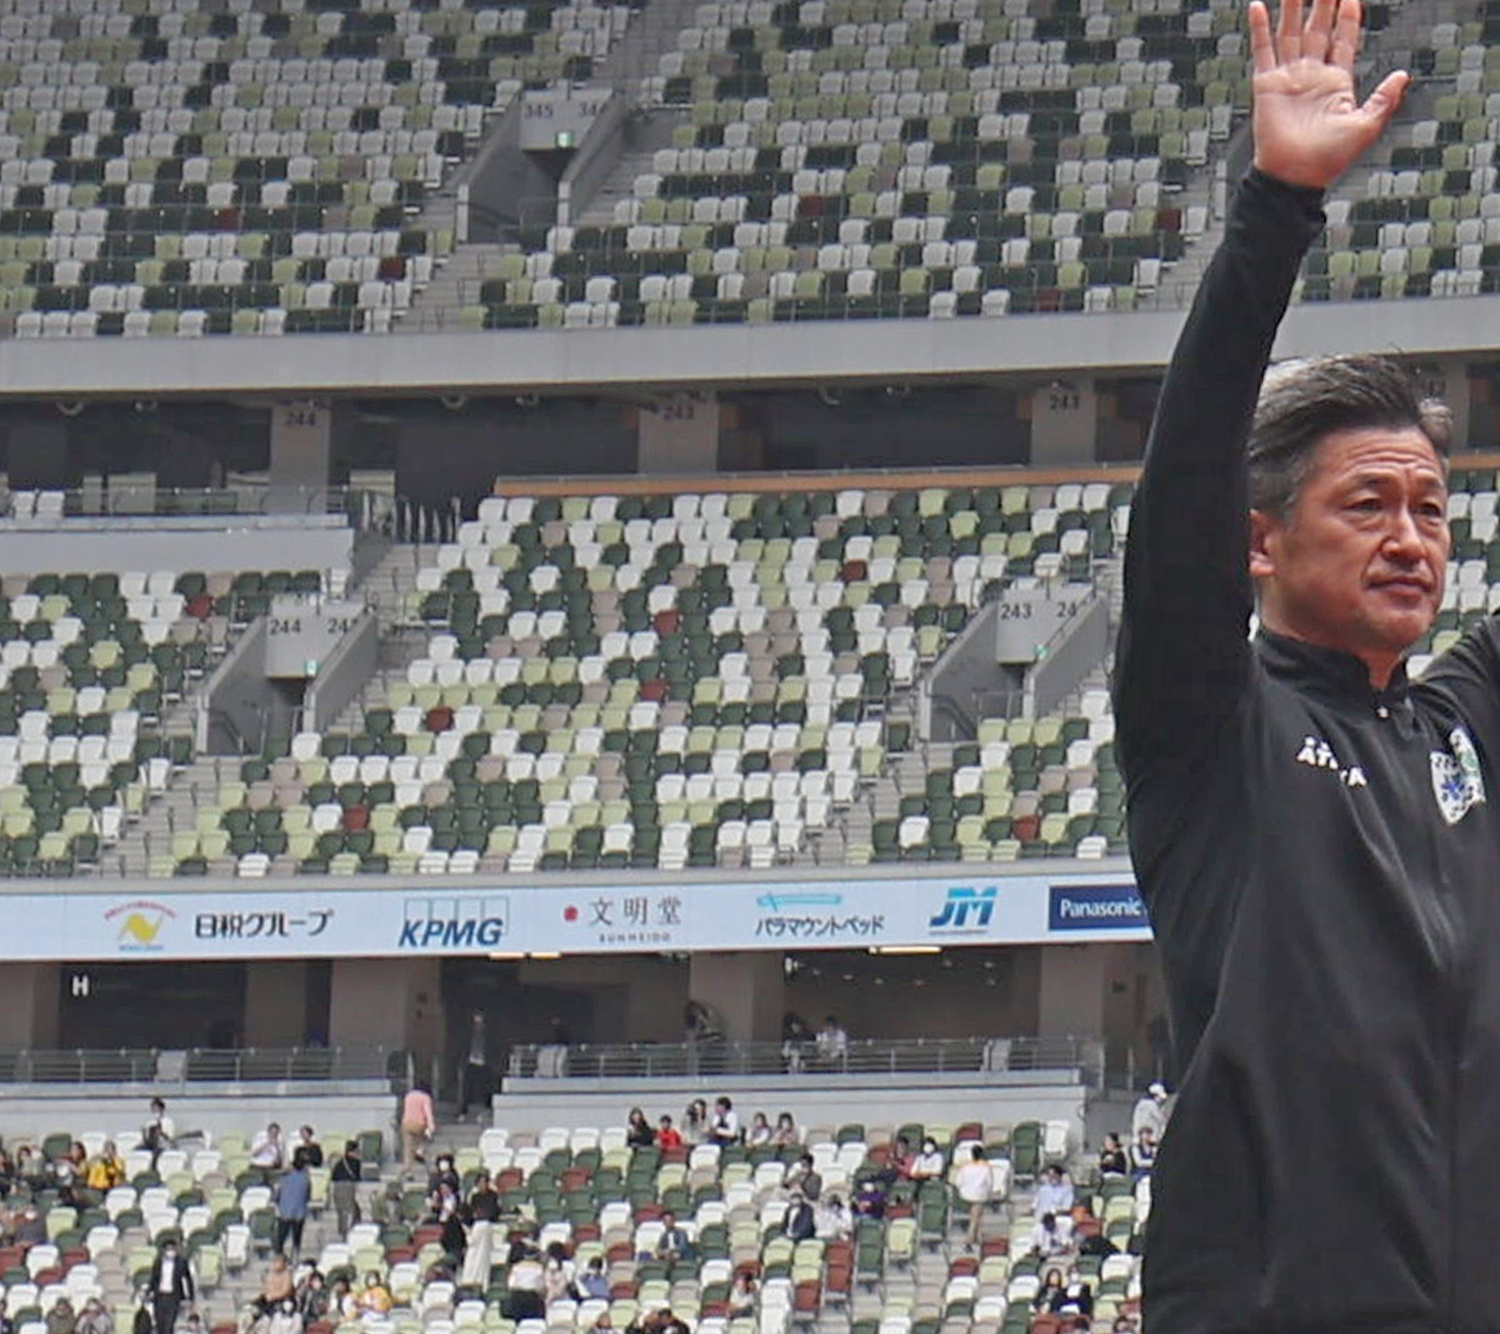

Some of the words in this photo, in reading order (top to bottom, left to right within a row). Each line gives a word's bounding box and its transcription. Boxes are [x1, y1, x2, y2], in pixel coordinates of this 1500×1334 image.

[1001, 603, 1031, 619] 243
[269, 618, 302, 635] 244
[590, 896, 682, 926] 文明堂
[1060, 897, 1142, 920] Panasonic
[195, 907, 335, 938] 日税グループ
[399, 917, 504, 947] KPMG
[754, 914, 885, 938] パラマウントベッド
